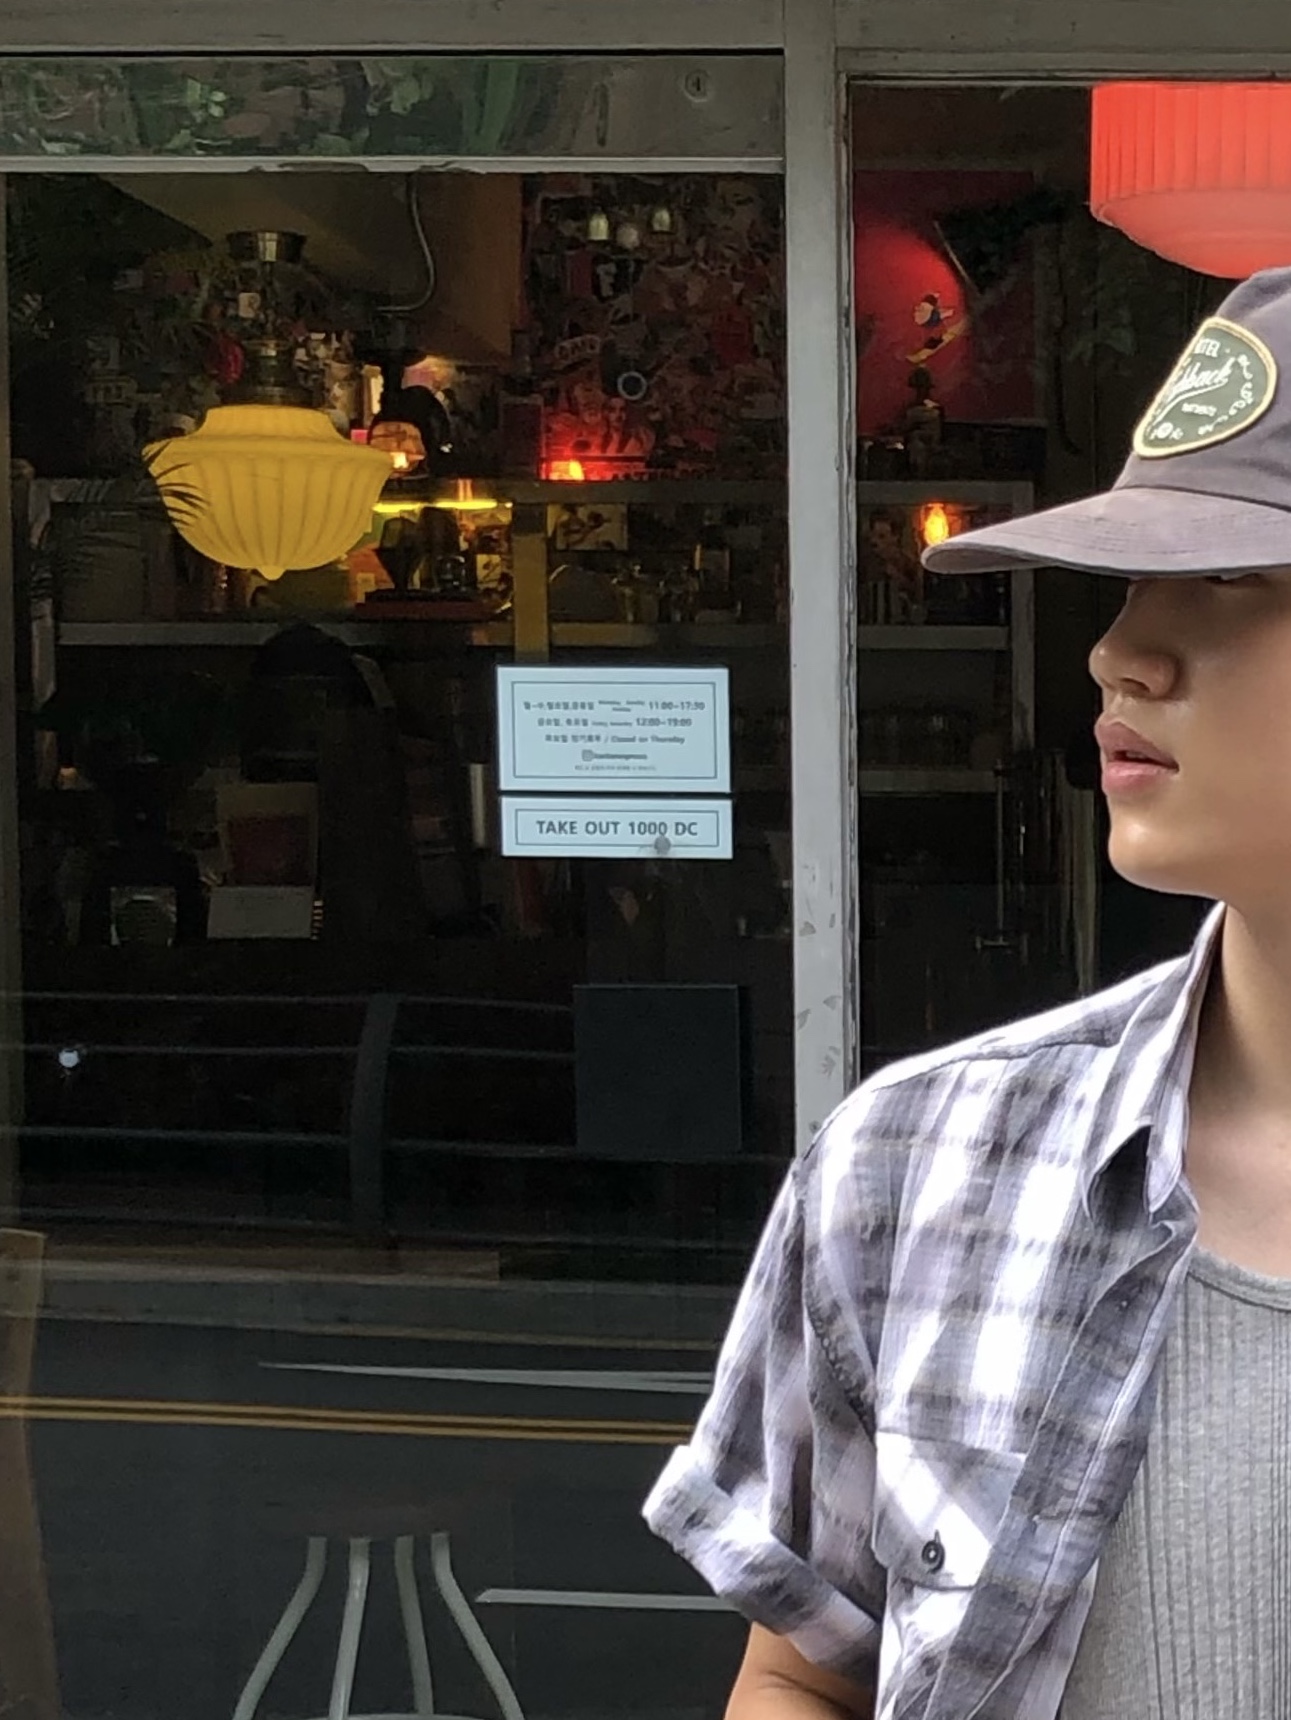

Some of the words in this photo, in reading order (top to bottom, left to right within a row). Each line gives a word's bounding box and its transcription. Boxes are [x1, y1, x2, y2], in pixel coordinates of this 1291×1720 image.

[536, 820, 578, 836] TAKE
[585, 820, 621, 836] OUT
[628, 821, 668, 837] 1000
[674, 821, 699, 838] DC
